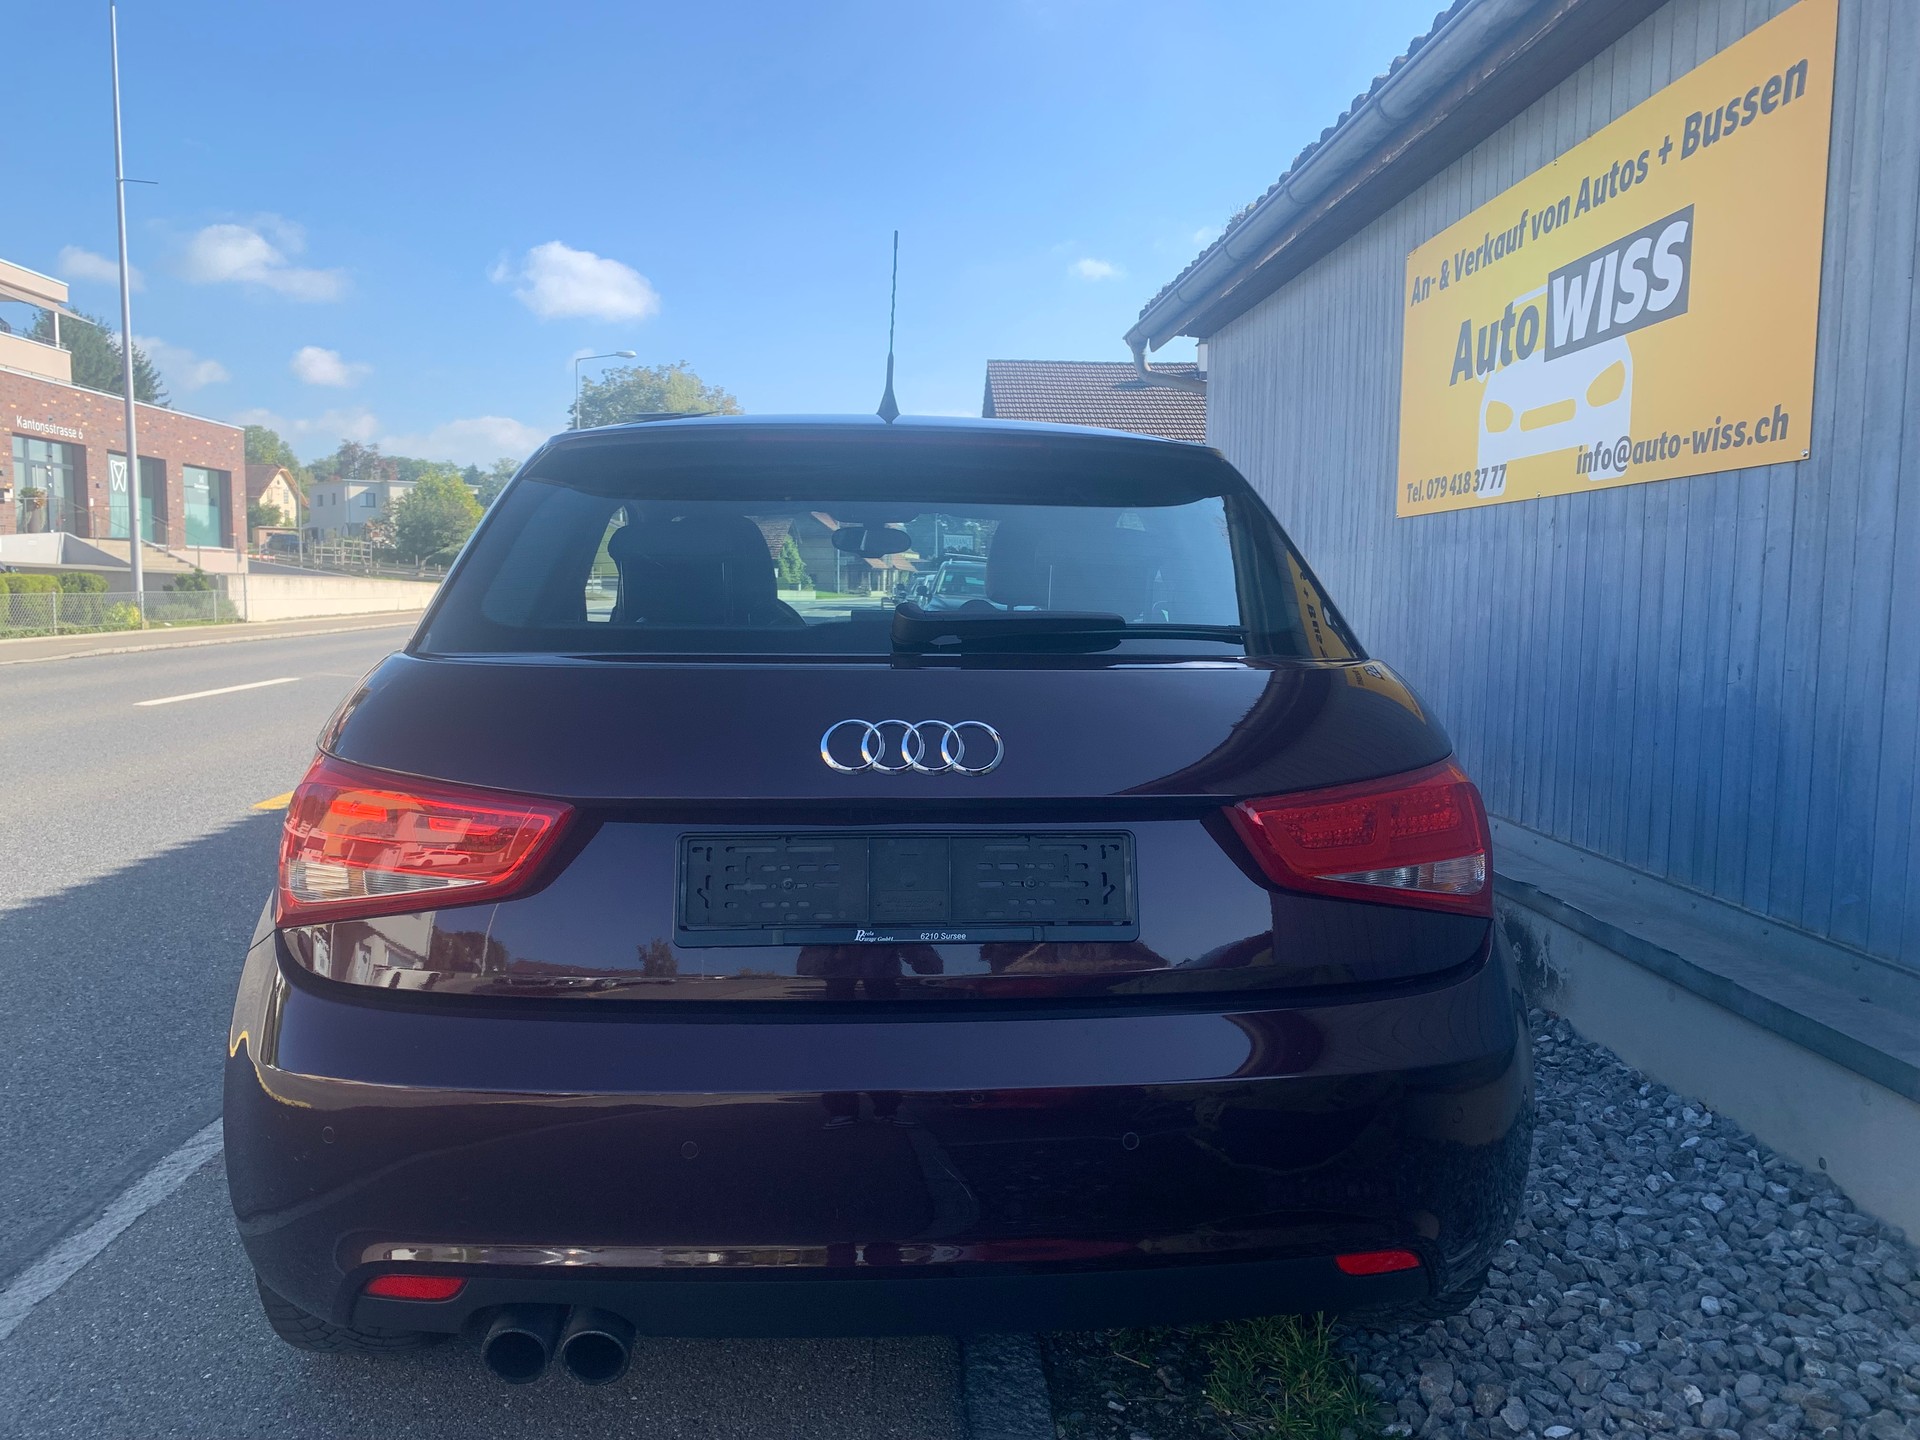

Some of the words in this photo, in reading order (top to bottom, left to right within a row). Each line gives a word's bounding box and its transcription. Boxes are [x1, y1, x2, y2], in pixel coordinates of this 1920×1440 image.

[1410, 276, 1437, 307] An-
[1439, 259, 1450, 291] &
[1454, 208, 1530, 283] Verkauf
[1532, 194, 1571, 241] von
[1573, 149, 1650, 220] Autos
[1657, 134, 1674, 166] +
[1680, 58, 1809, 161] Bussen
[1449, 301, 1541, 387] Auto
[1551, 220, 1690, 350] WISS
[16, 415, 77, 438] Kantonsstrasse
[78, 427, 84, 440] 6
[1576, 403, 1790, 475] info@auto-wiss.ch
[1407, 479, 1425, 504] Tel.
[1426, 475, 1448, 500] 079
[1449, 470, 1472, 496] 418
[920, 932, 939, 940] 6210
[940, 932, 967, 940] Sursee
